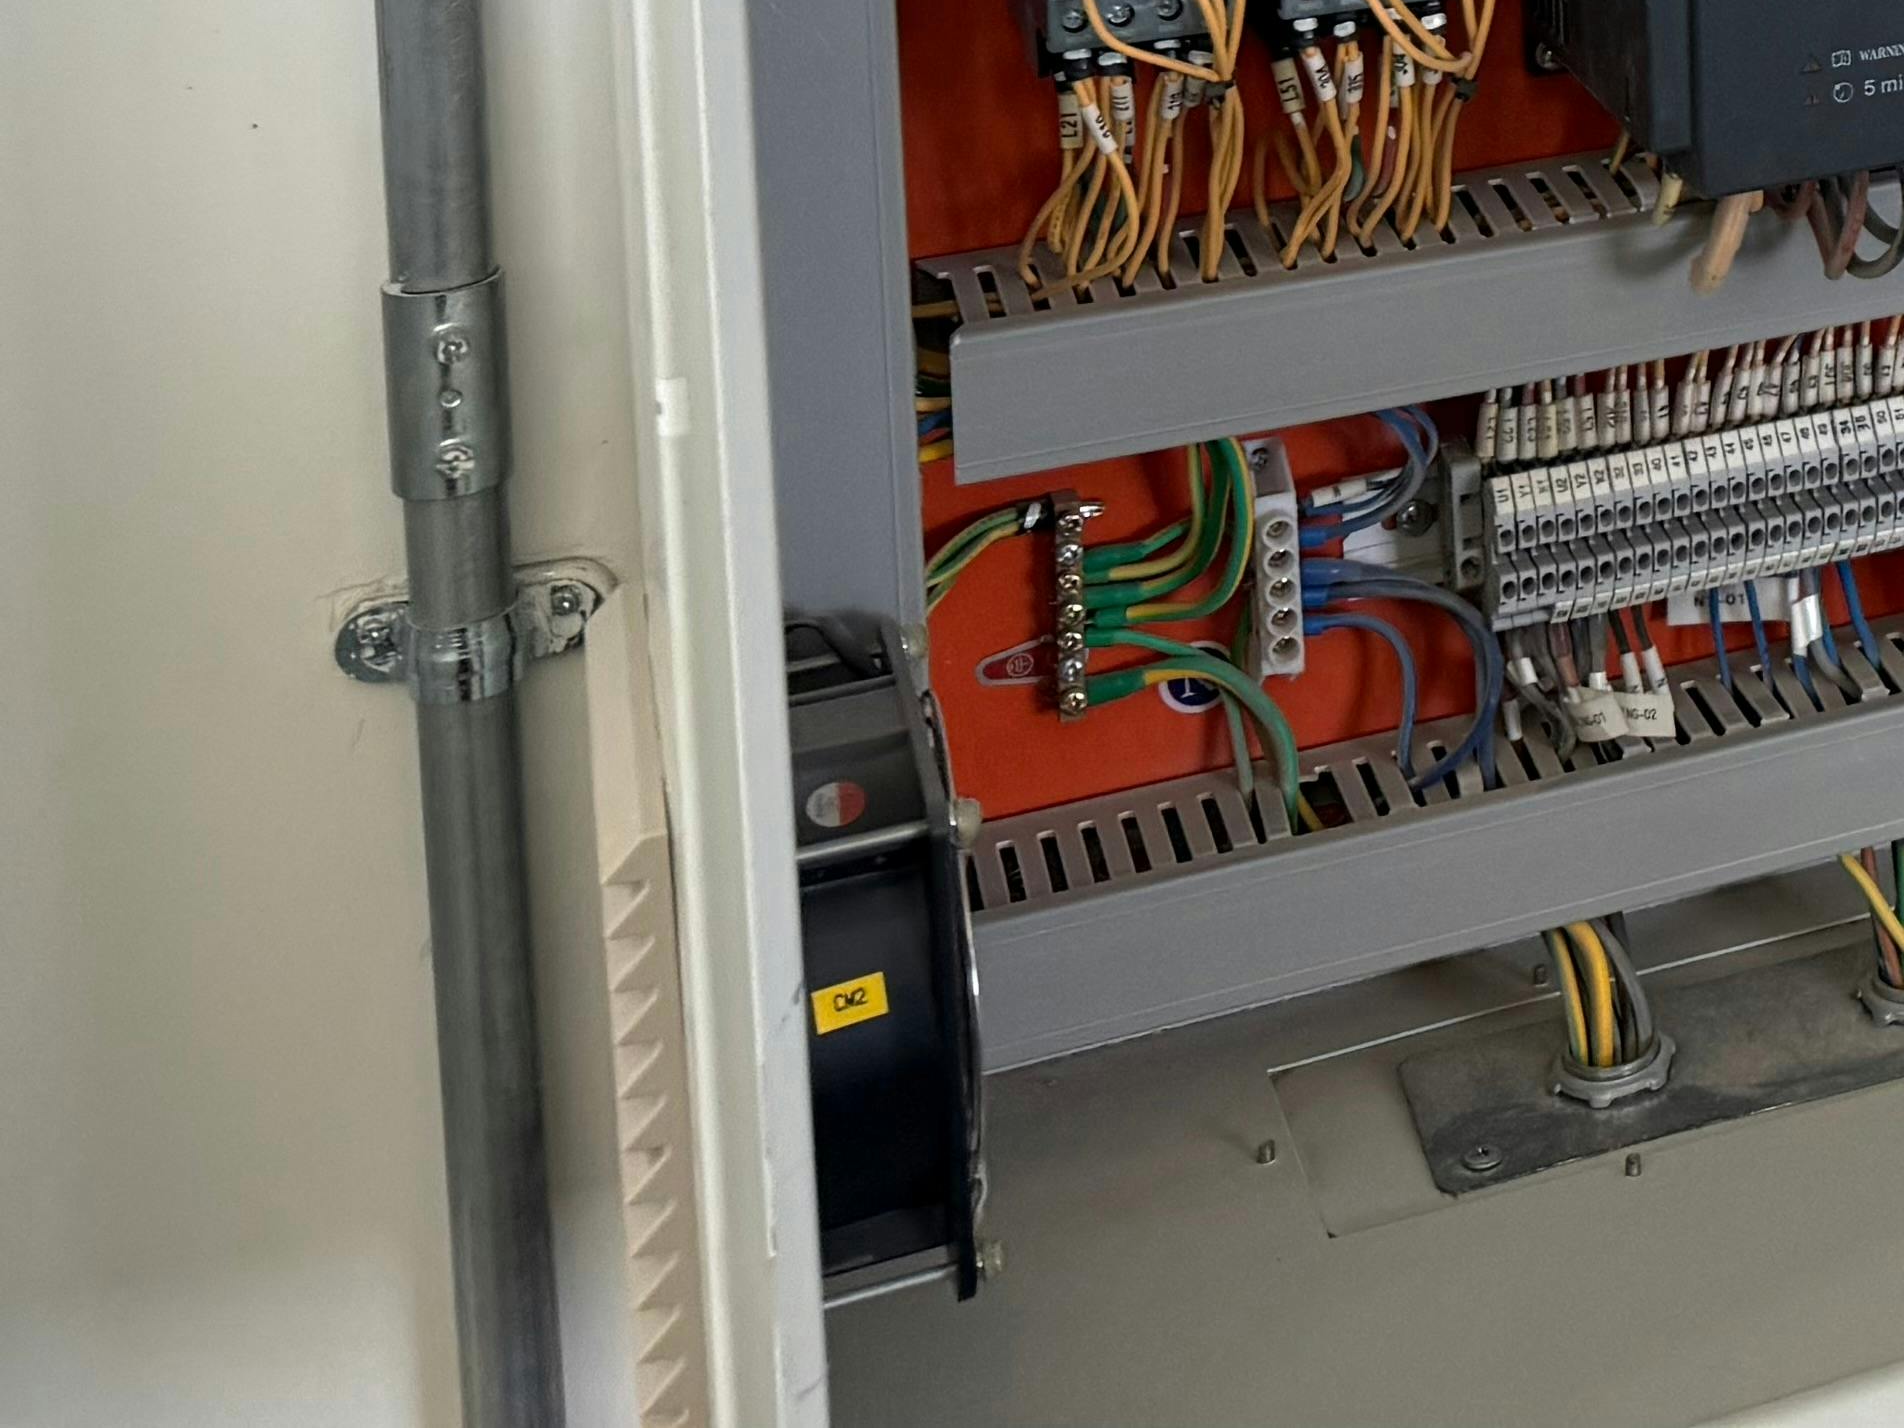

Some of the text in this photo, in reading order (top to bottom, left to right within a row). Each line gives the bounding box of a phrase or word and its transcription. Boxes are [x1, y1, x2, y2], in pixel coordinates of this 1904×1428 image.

[1279, 77, 1297, 102] L51
[1864, 79, 1876, 96] 5
[1061, 113, 1078, 138] L21
